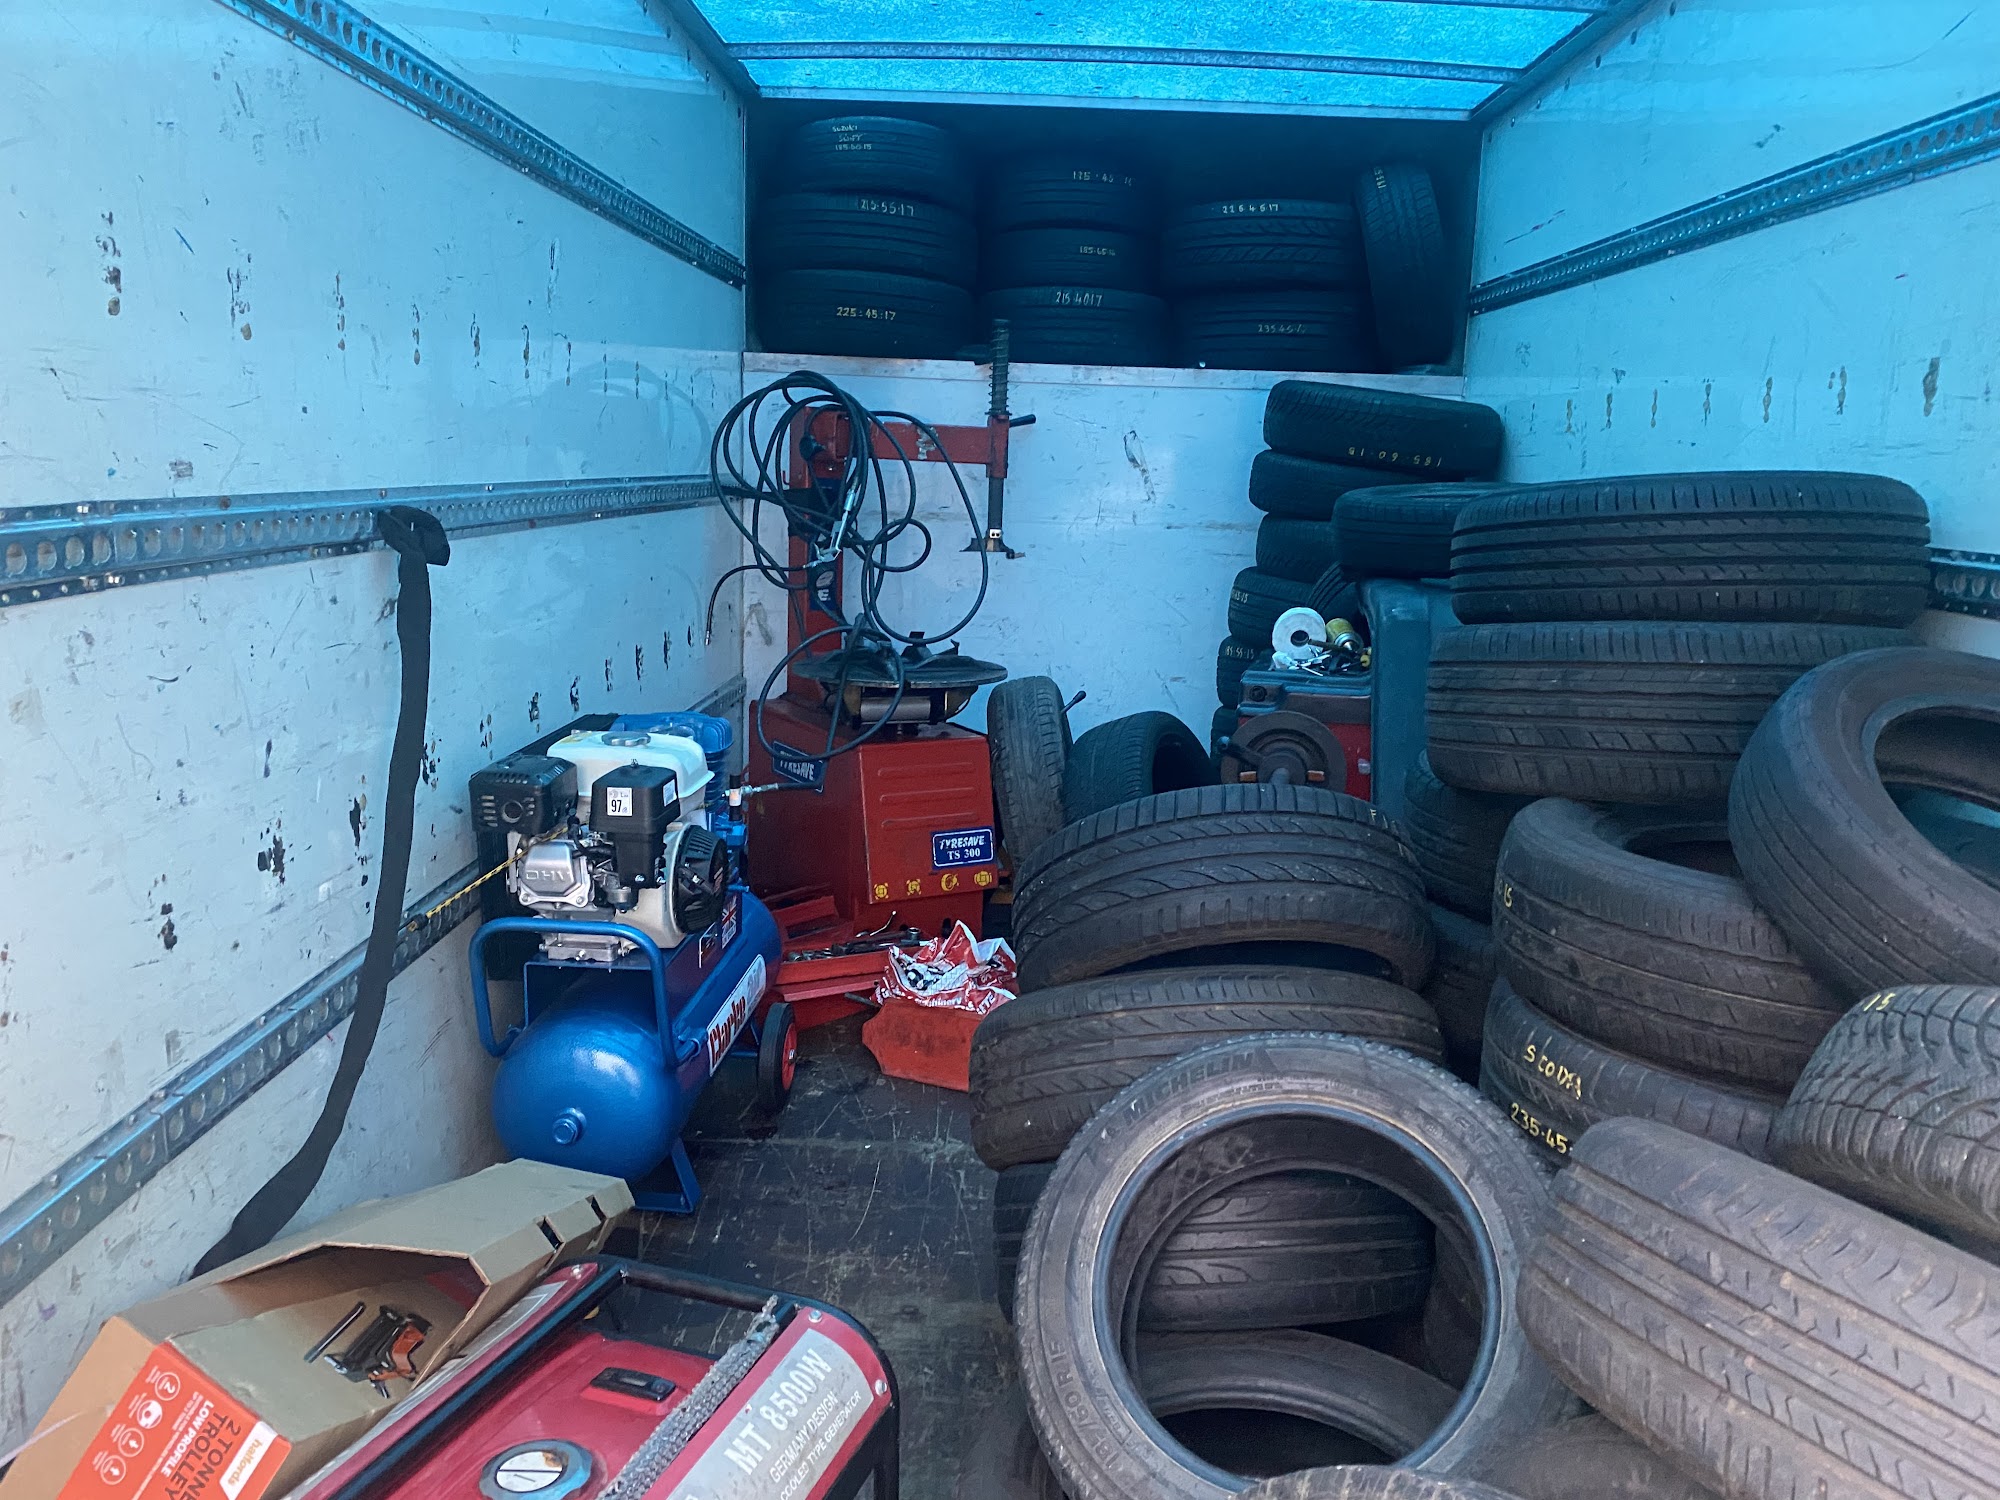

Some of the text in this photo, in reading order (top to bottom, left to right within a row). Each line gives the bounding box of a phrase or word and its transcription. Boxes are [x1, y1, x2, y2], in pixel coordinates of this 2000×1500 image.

[611, 799, 622, 813] 97
[939, 835, 985, 850] TYRESAVE
[947, 848, 981, 861] TS 300
[1122, 1051, 1255, 1126] MICHELIN
[192, 1400, 215, 1430] LOW
[226, 1419, 241, 1436] 2
[723, 1347, 833, 1475] MT 8500W
[807, 1437, 827, 1465] TYPE
[824, 1390, 862, 1443] GENERATOR
[161, 1427, 197, 1478] PROFILE
[769, 1390, 839, 1483] GERMANY DESIGN
[227, 1438, 263, 1487] halfords
